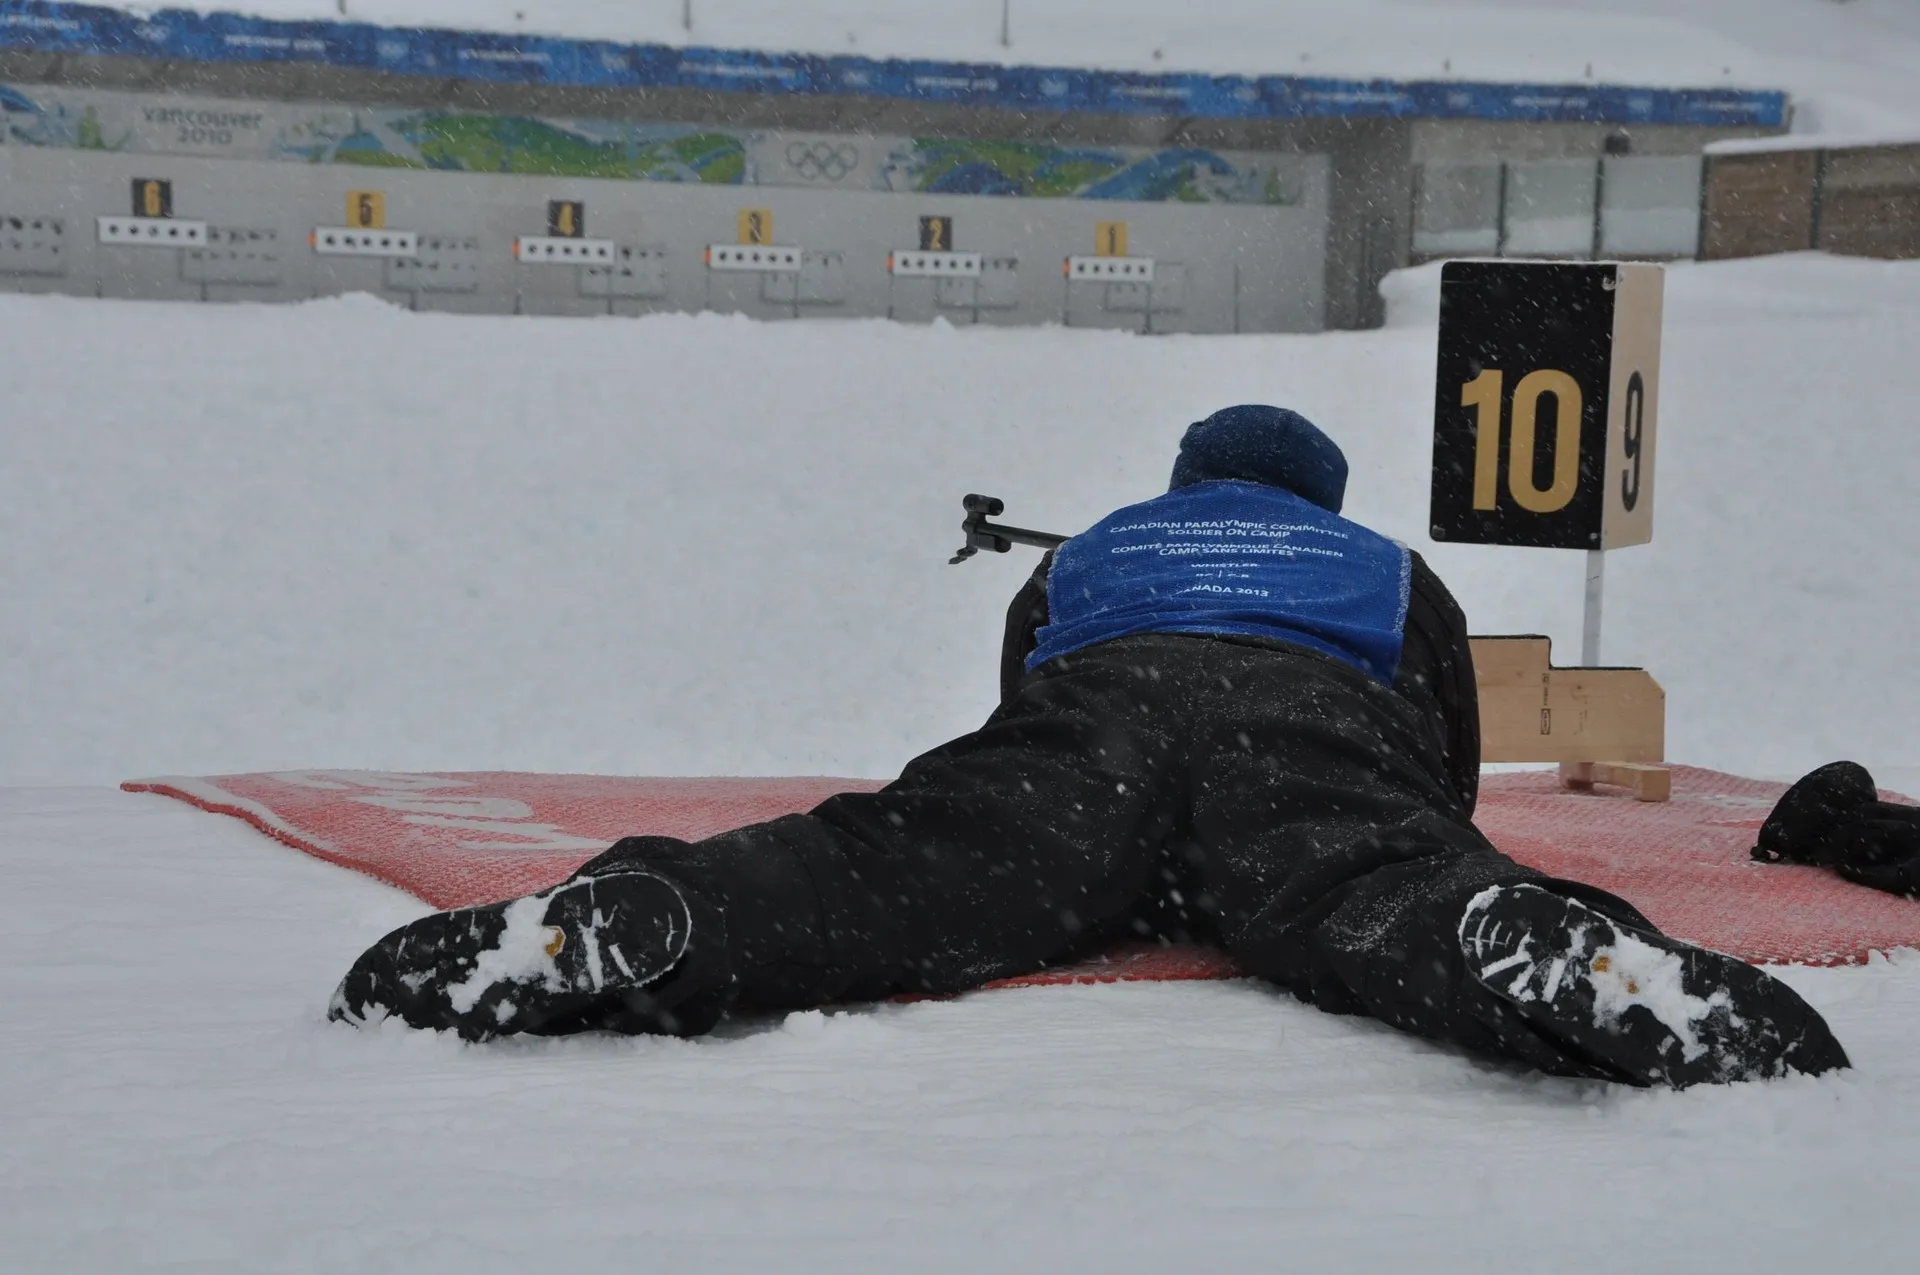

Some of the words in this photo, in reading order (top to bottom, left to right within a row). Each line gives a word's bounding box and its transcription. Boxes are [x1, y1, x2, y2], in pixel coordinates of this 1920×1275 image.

[177, 127, 233, 145] 2010
[929, 217, 944, 251] 2
[1108, 224, 1117, 256] 1
[1461, 368, 1583, 513] 10
[1621, 370, 1644, 512] 9
[1109, 521, 1181, 533] CANADIAN
[1184, 519, 1268, 530] PARALYMPIC
[1270, 523, 1349, 540] COMMITTEE
[1226, 528, 1247, 536] ON
[1250, 530, 1291, 538] CAMP
[1111, 542, 1162, 554] COMITÉ
[1272, 543, 1344, 558] CANADIEN
[1159, 547, 1200, 556] CAMP
[1242, 548, 1294, 556] LIMITES
[1175, 584, 1232, 595] ANADA
[1236, 587, 1270, 597] 2013
